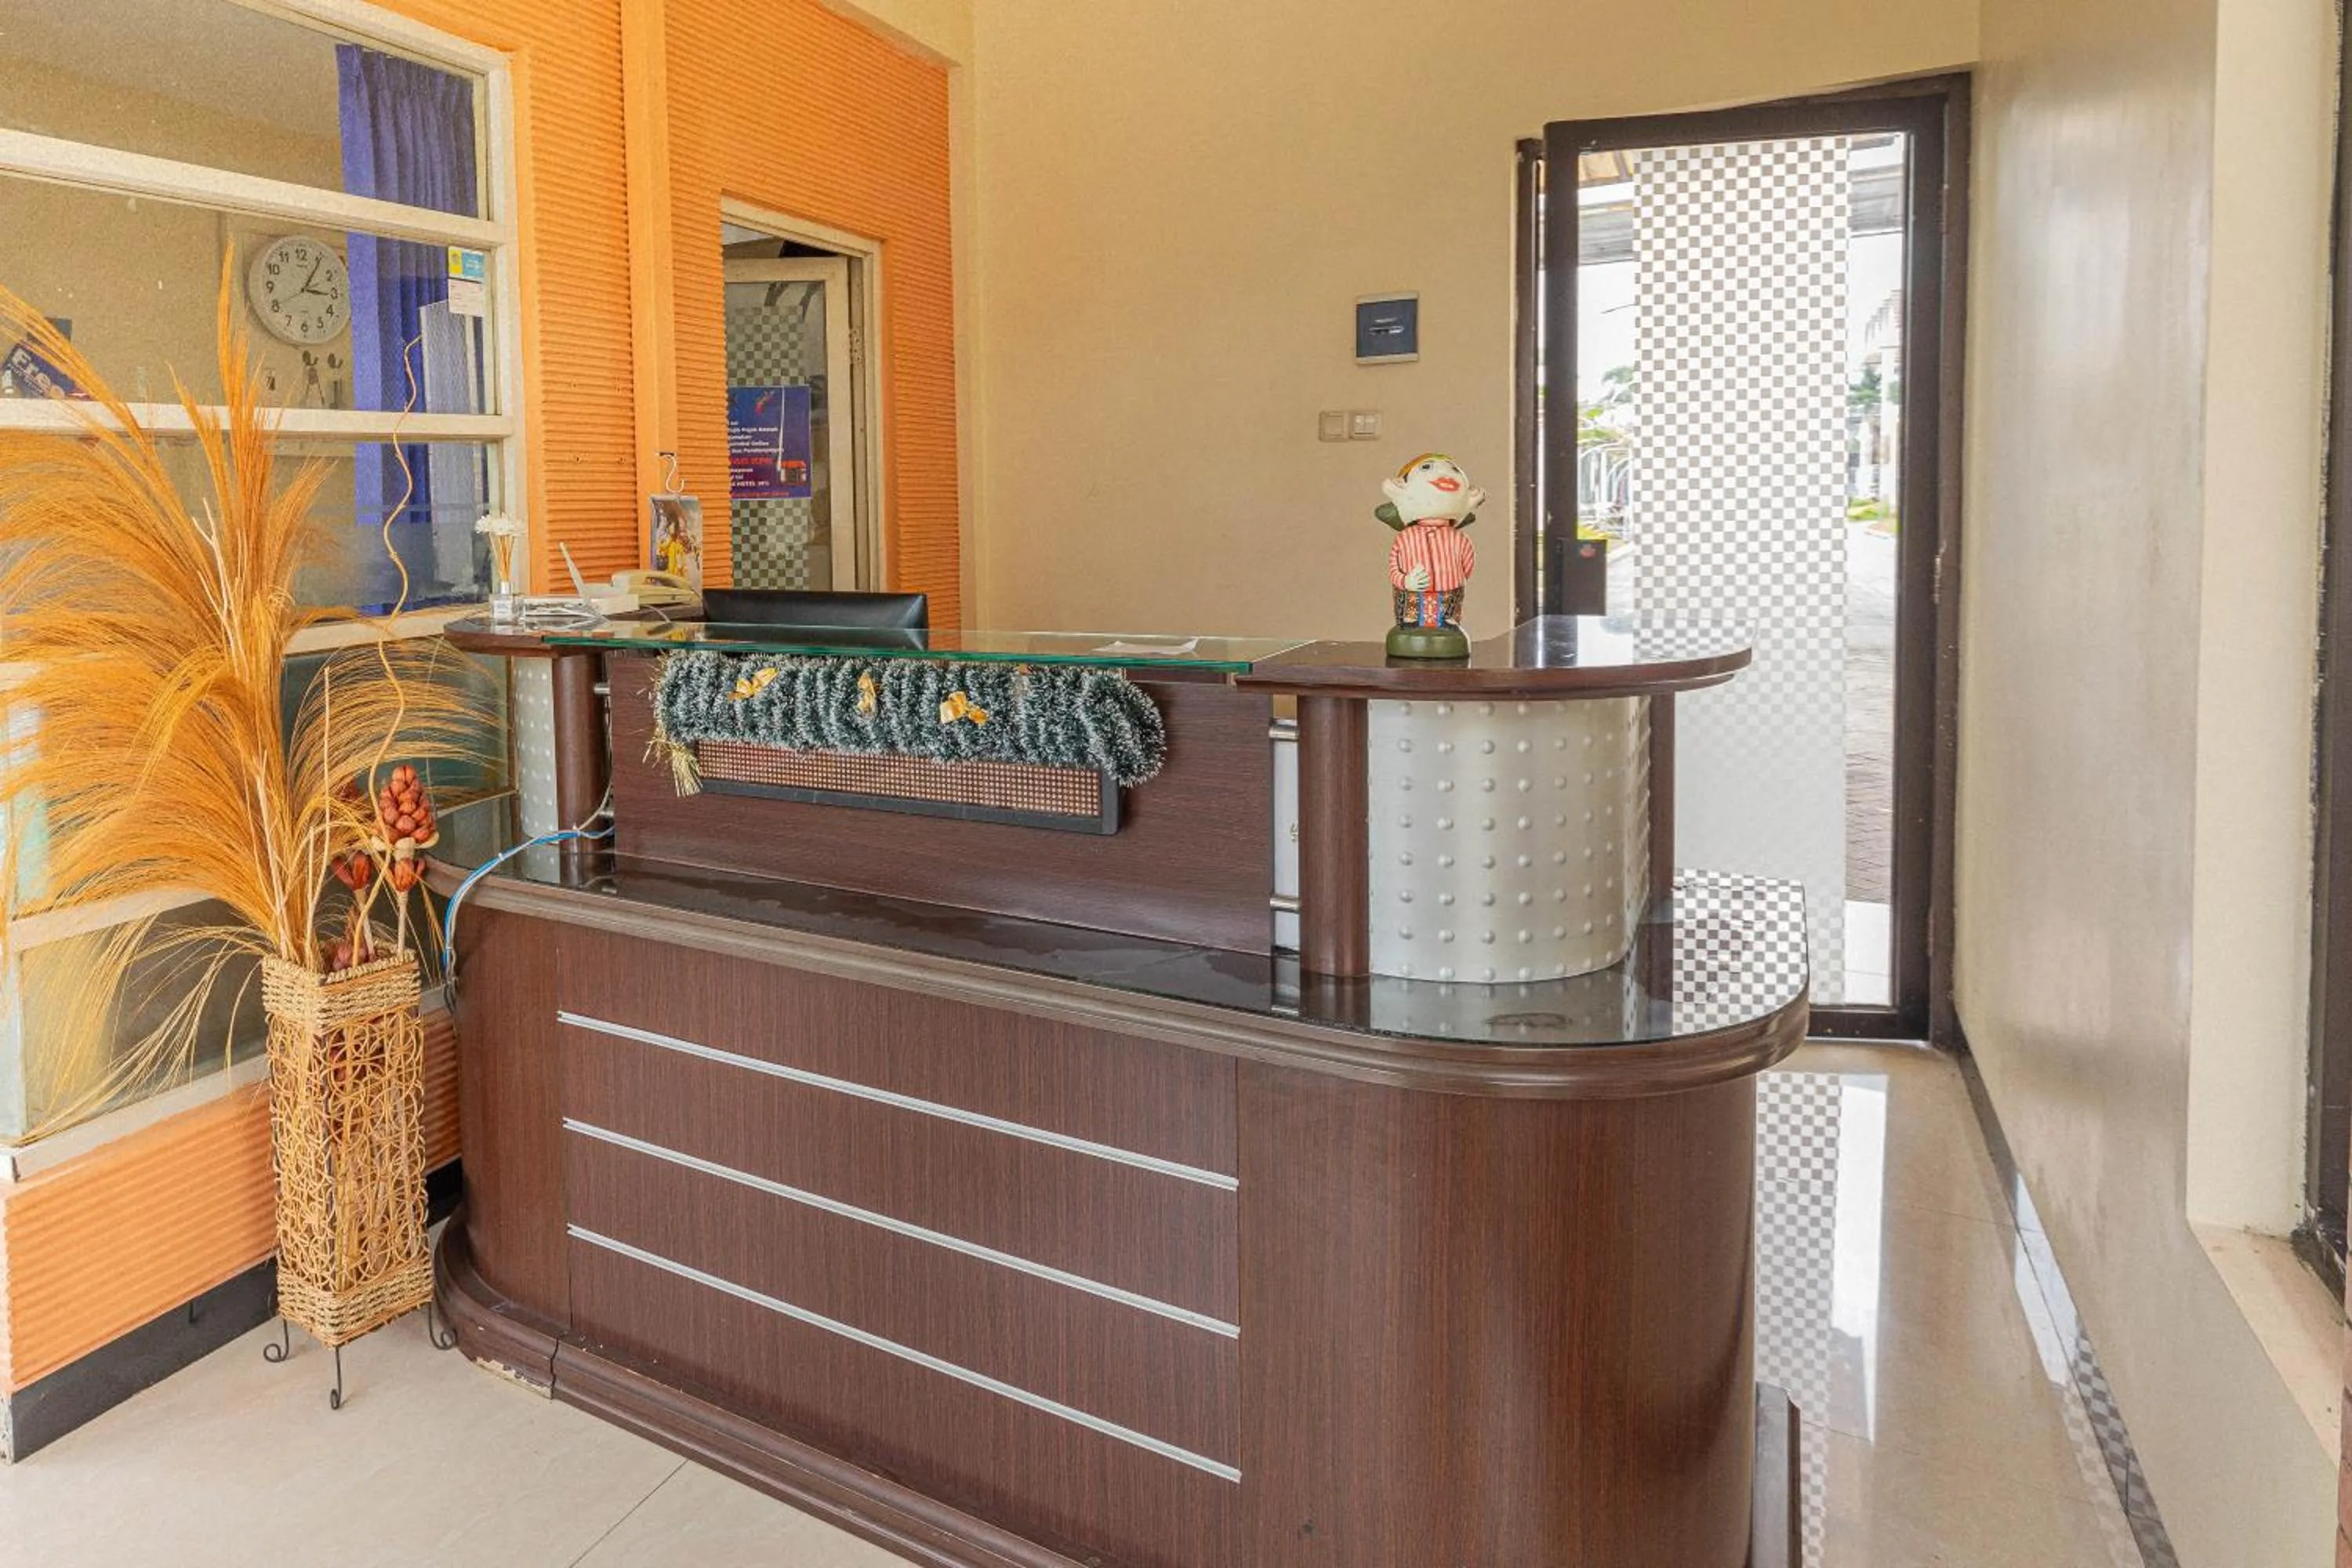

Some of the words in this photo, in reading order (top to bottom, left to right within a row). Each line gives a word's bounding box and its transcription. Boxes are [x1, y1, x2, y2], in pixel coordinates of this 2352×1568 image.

[279, 250, 289, 263] 11
[295, 248, 308, 261] 12
[267, 263, 280, 275] 10
[325, 269, 333, 281] 2
[266, 281, 274, 293] 9
[330, 287, 338, 299] 3
[271, 299, 280, 313] 8
[325, 304, 334, 317] 4
[285, 314, 292, 326] 7
[317, 316, 324, 328] 5
[301, 321, 308, 333] 6
